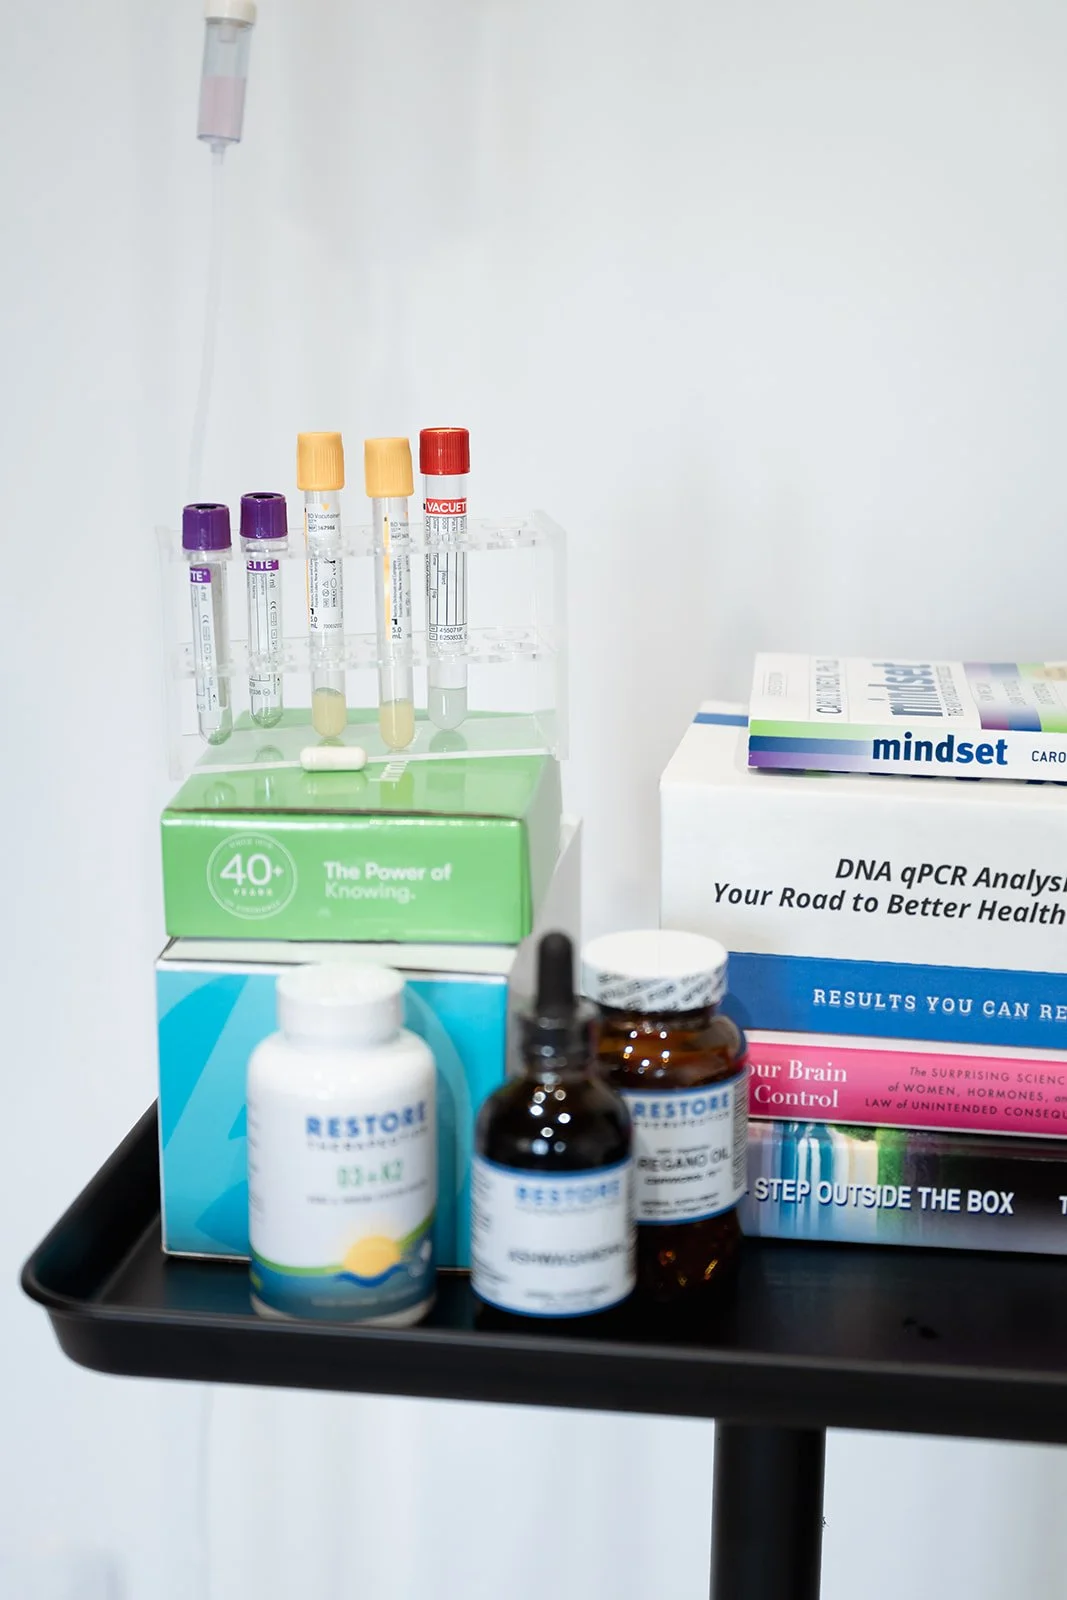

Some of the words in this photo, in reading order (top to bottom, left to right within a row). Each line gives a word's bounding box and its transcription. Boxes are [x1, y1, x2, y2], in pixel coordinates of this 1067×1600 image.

[426, 501, 466, 513] VACUET
[872, 731, 1008, 766] mindset
[1031, 750, 1066, 763] CARO
[324, 861, 360, 880] The
[365, 862, 426, 880] Power
[430, 862, 452, 880] of
[834, 858, 892, 882] DNA
[900, 862, 968, 892] qPCR
[325, 880, 416, 904] Knowing.
[713, 882, 773, 906] Your
[779, 886, 845, 912] Road
[852, 890, 879, 914] to
[887, 894, 971, 919] Better
[977, 900, 1066, 925] Health
[813, 988, 916, 1010] RESULTS
[928, 996, 972, 1015] YOU
[983, 1000, 1030, 1018] CAN
[1040, 1004, 1067, 1020] RE
[748, 1064, 781, 1078] our
[788, 1060, 847, 1082] Brain
[910, 1067, 927, 1077] The
[932, 1068, 1009, 1082] SURPRISING
[1017, 1073, 1065, 1086] SCIENC
[634, 1092, 729, 1118] RESTORE
[754, 1084, 838, 1108] Control
[888, 1083, 900, 1092] of
[904, 1084, 960, 1098] WOMEN,
[967, 1088, 1049, 1103] HORMONES,
[865, 1098, 892, 1108] LAW
[897, 1099, 908, 1109] of
[911, 1101, 998, 1115] UNINTENDED
[307, 1101, 426, 1138] RESTORE
[638, 1153, 708, 1171] REGANO
[754, 1178, 810, 1202] STEP
[816, 1180, 912, 1208] OUTSIDE
[917, 1186, 961, 1212] THE
[966, 1190, 1015, 1214] BOX
